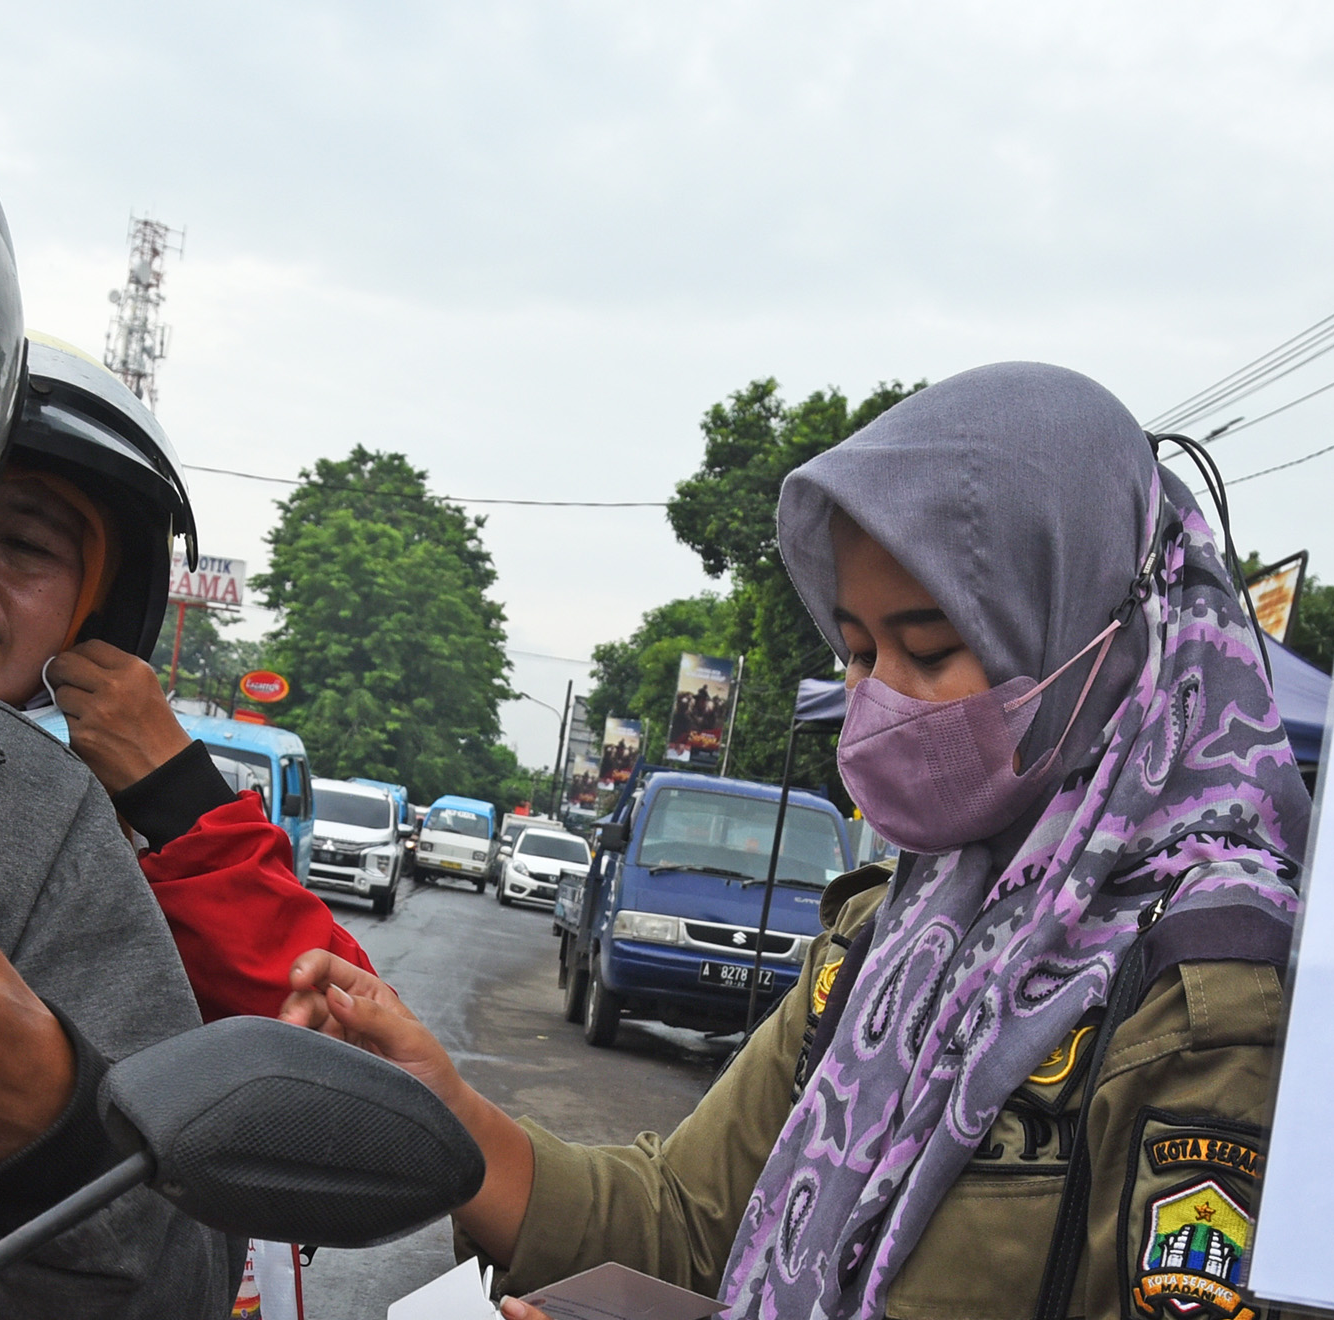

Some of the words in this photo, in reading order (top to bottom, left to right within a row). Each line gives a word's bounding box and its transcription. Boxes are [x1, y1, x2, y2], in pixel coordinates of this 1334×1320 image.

[702, 962, 710, 977] A
[721, 965, 749, 982] 8278
[1155, 1139, 1202, 1163] KOTA
[1147, 1274, 1178, 1289] KOTA
[1182, 1275, 1234, 1301] SERANG
[1160, 1283, 1217, 1304] MADANI
